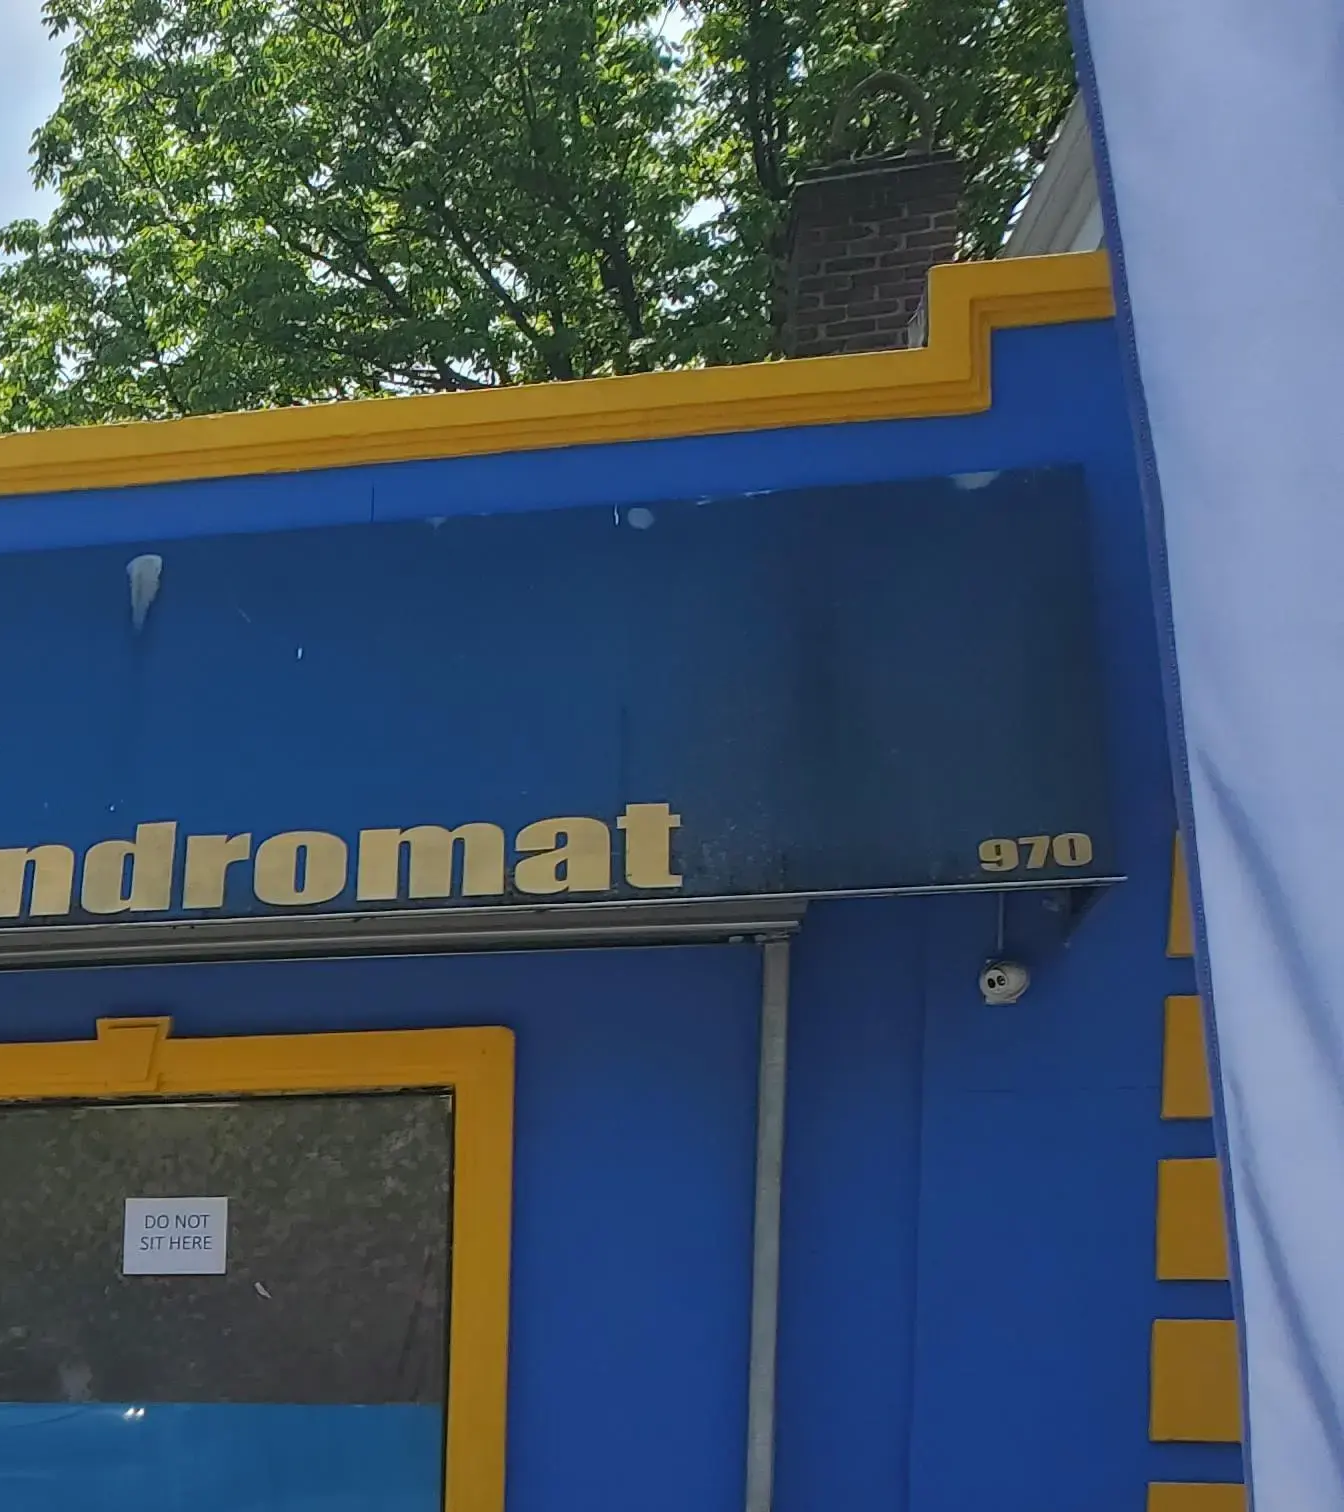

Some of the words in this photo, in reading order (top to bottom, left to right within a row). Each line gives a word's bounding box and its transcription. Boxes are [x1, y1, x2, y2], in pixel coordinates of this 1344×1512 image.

[978, 832, 1093, 872] 970
[144, 1214, 170, 1229] DO
[175, 1214, 211, 1229] NOT
[139, 1236, 166, 1251] SIT
[169, 1235, 213, 1250] HERE
